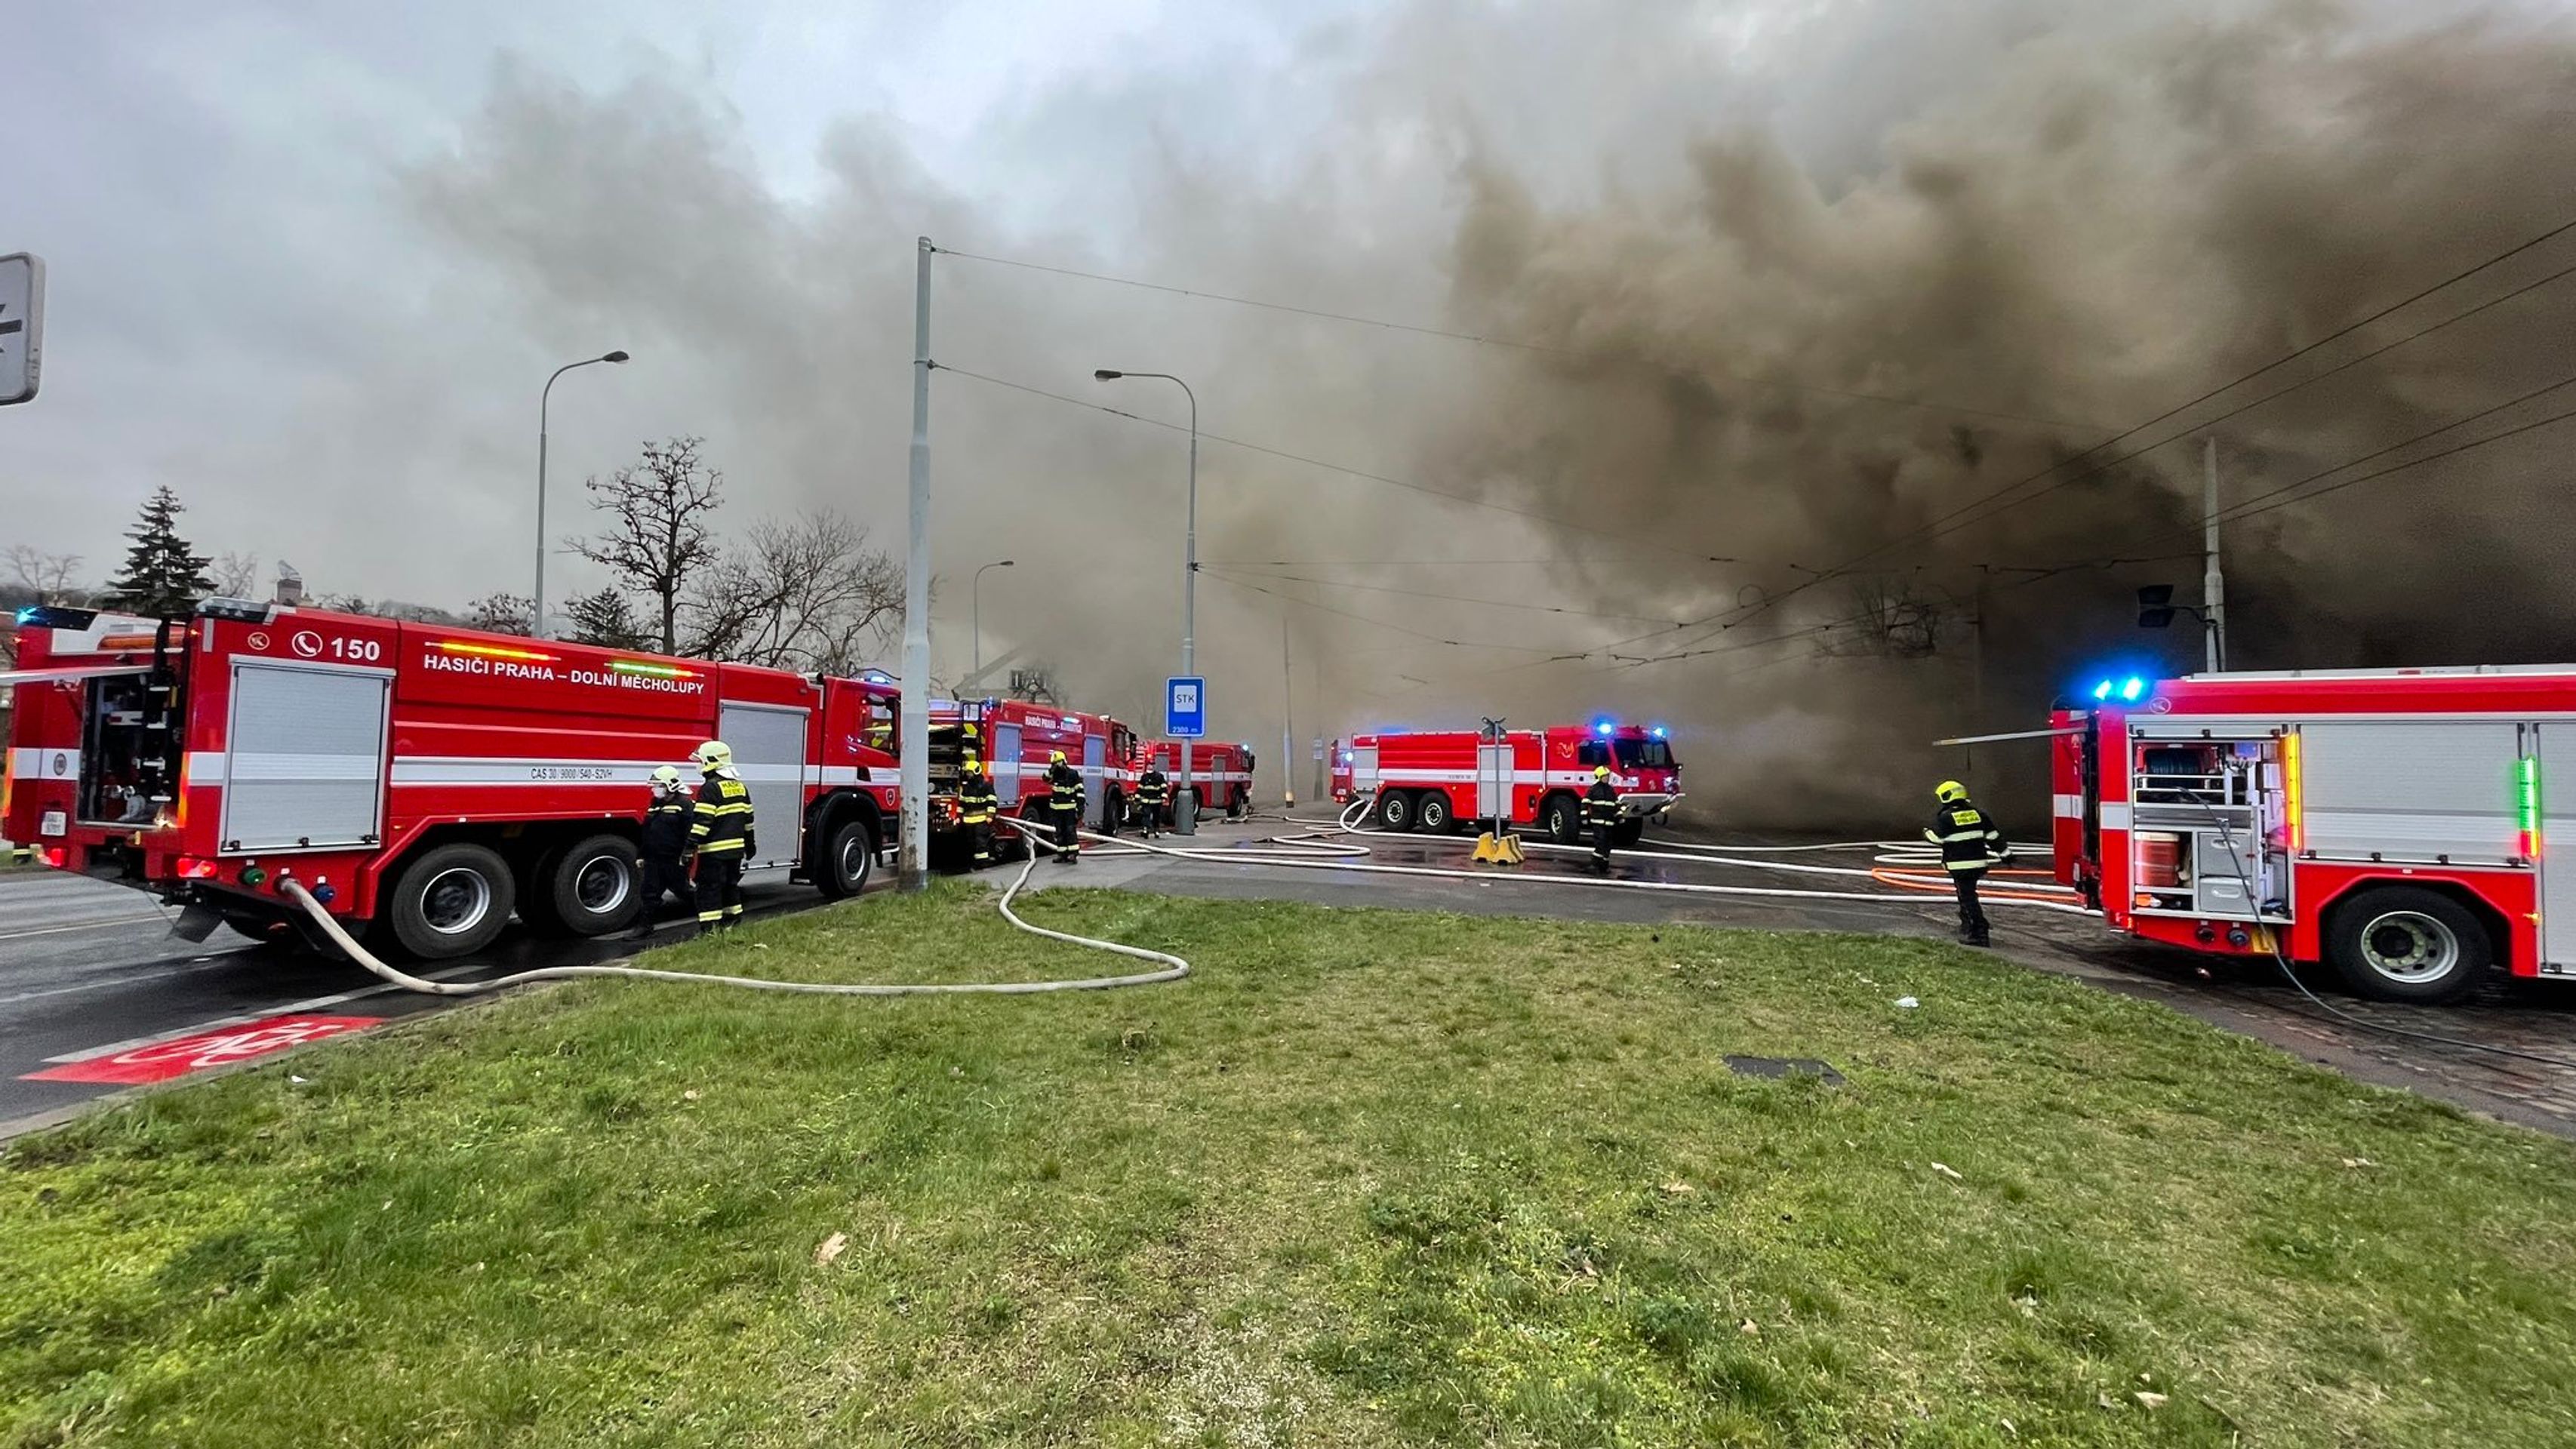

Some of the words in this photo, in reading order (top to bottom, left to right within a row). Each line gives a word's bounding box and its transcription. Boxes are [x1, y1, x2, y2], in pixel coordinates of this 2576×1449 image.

[331, 637, 380, 661] 150
[423, 654, 489, 674] HASIČI
[494, 661, 554, 681] PRAHA
[571, 670, 617, 687] DOLNÍ
[620, 675, 704, 695] MĚCHOLUPY
[1176, 694, 1195, 703] STK
[531, 768, 547, 780] CAS
